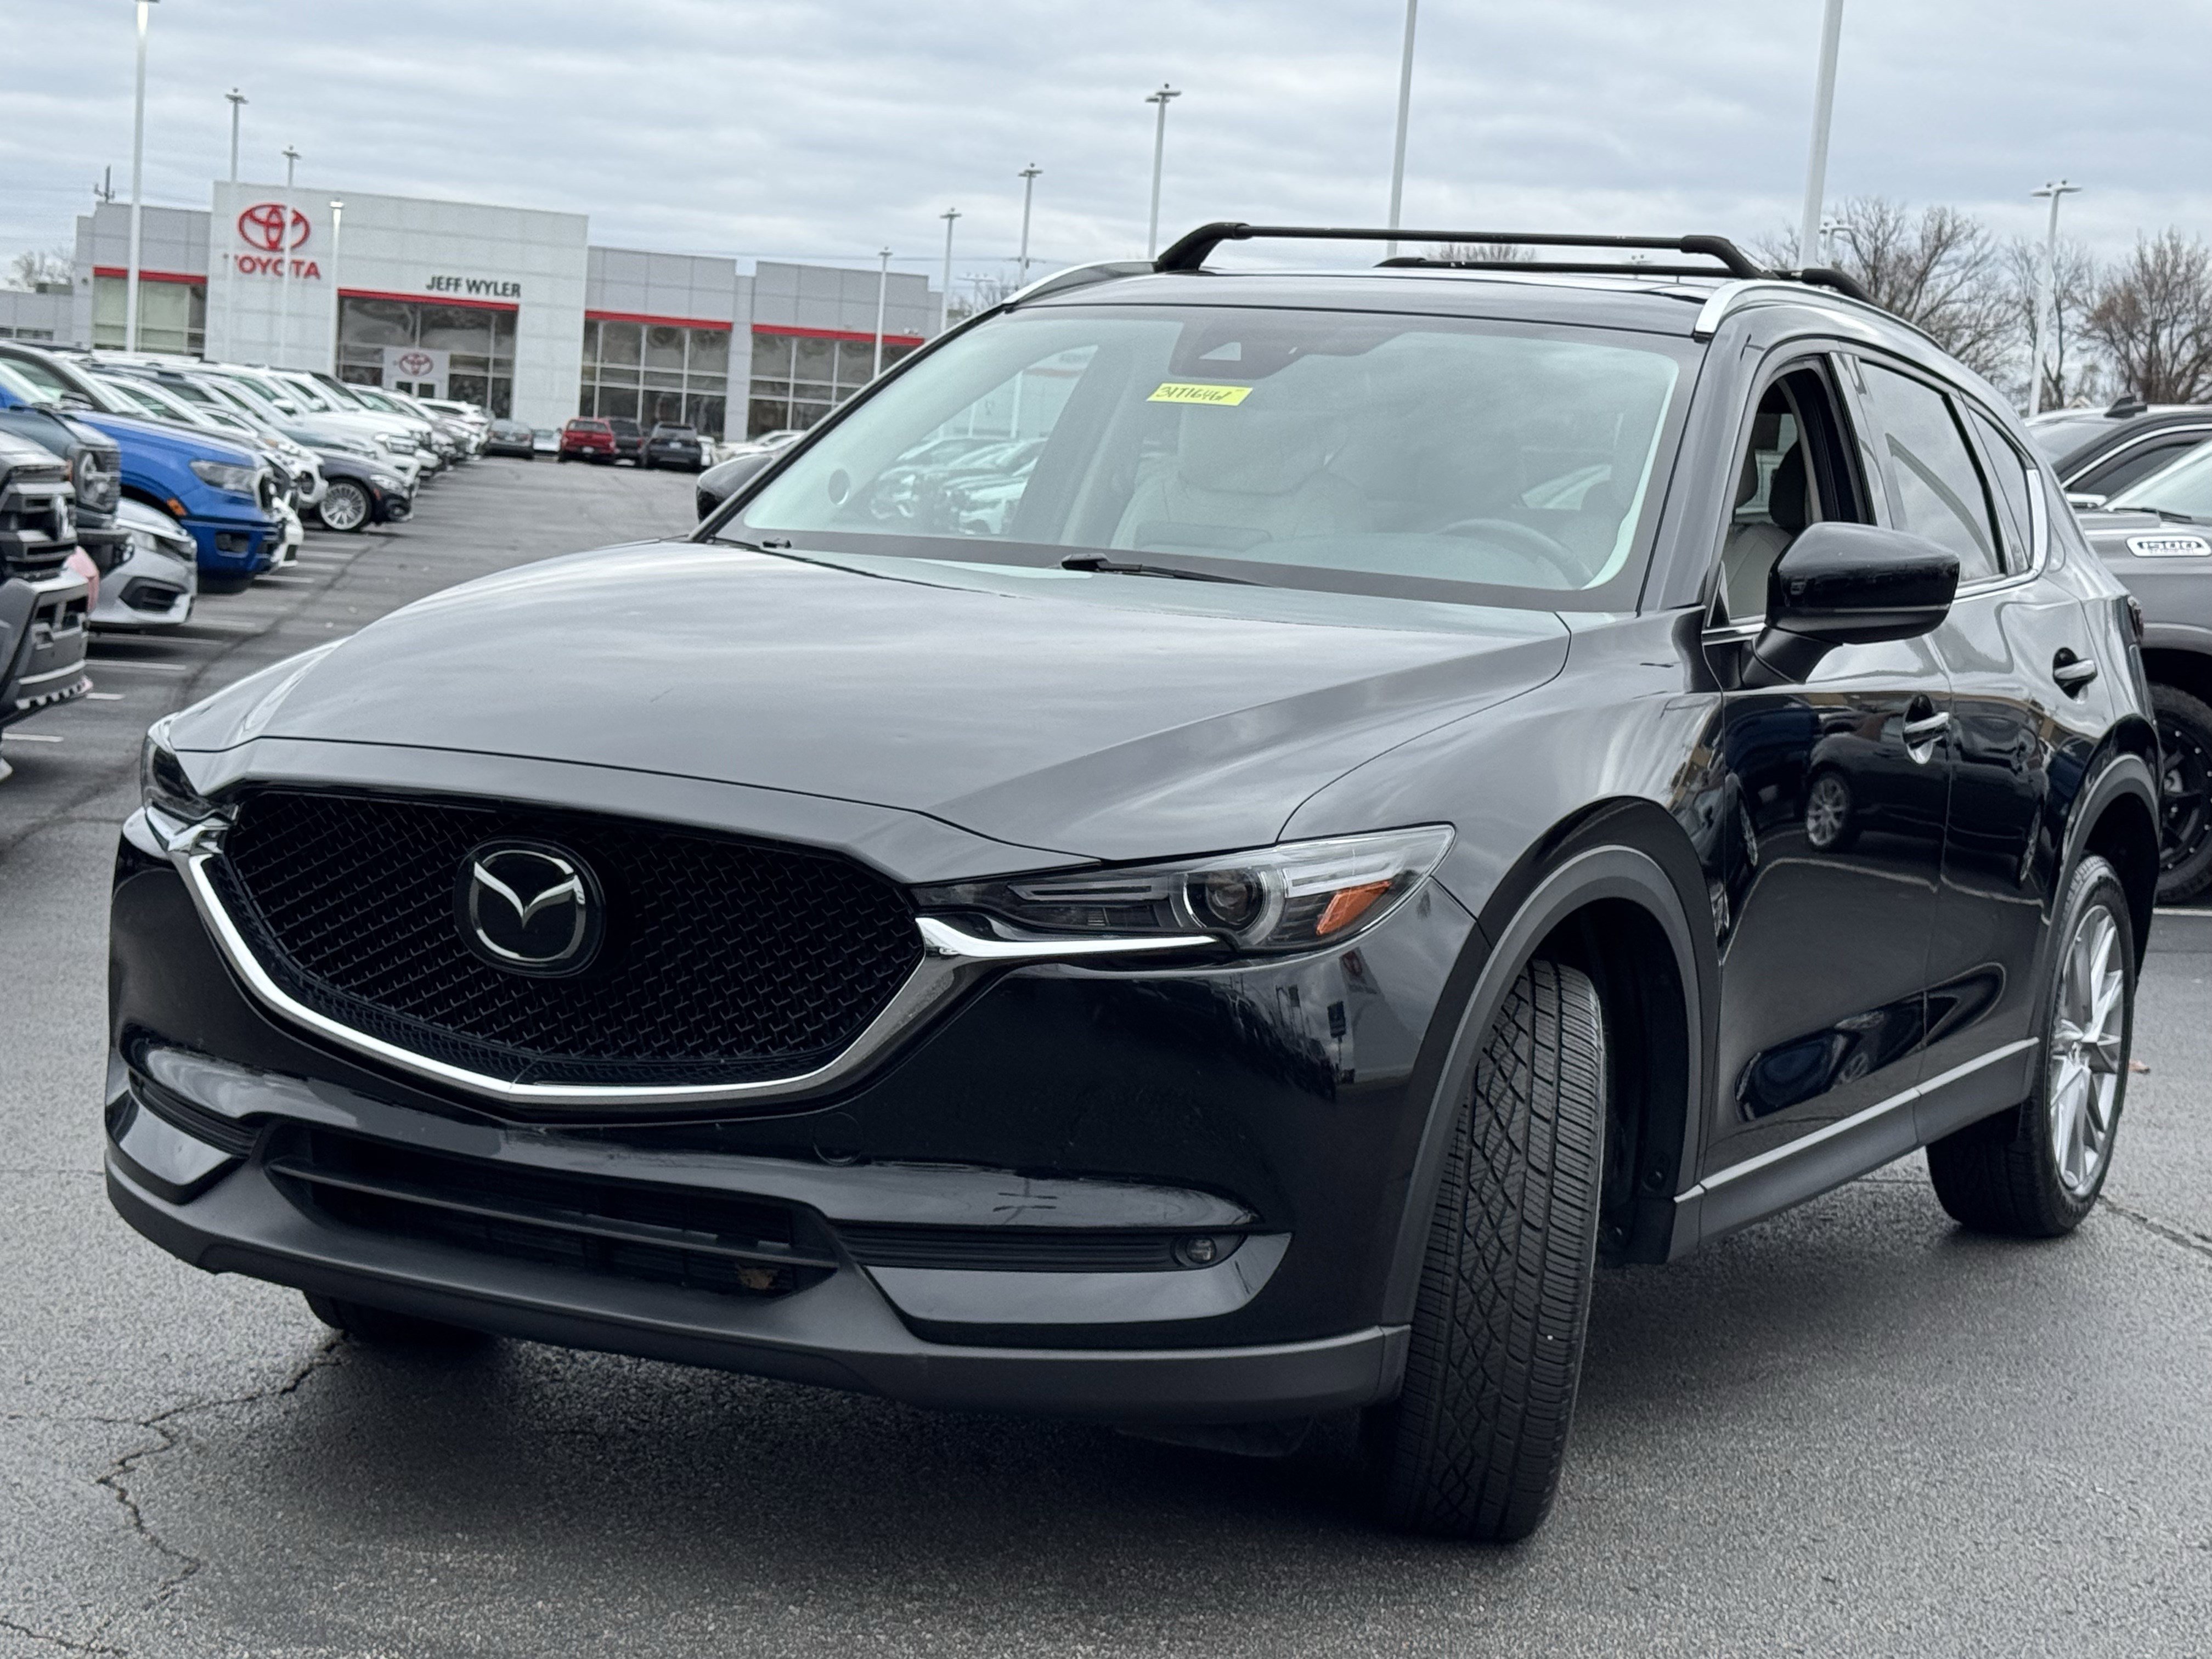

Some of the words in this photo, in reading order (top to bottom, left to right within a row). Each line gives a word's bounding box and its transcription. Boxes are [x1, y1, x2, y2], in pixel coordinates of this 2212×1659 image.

[223, 254, 321, 280] OYOTA
[426, 275, 462, 293] JEFF
[466, 278, 521, 298] WYLER
